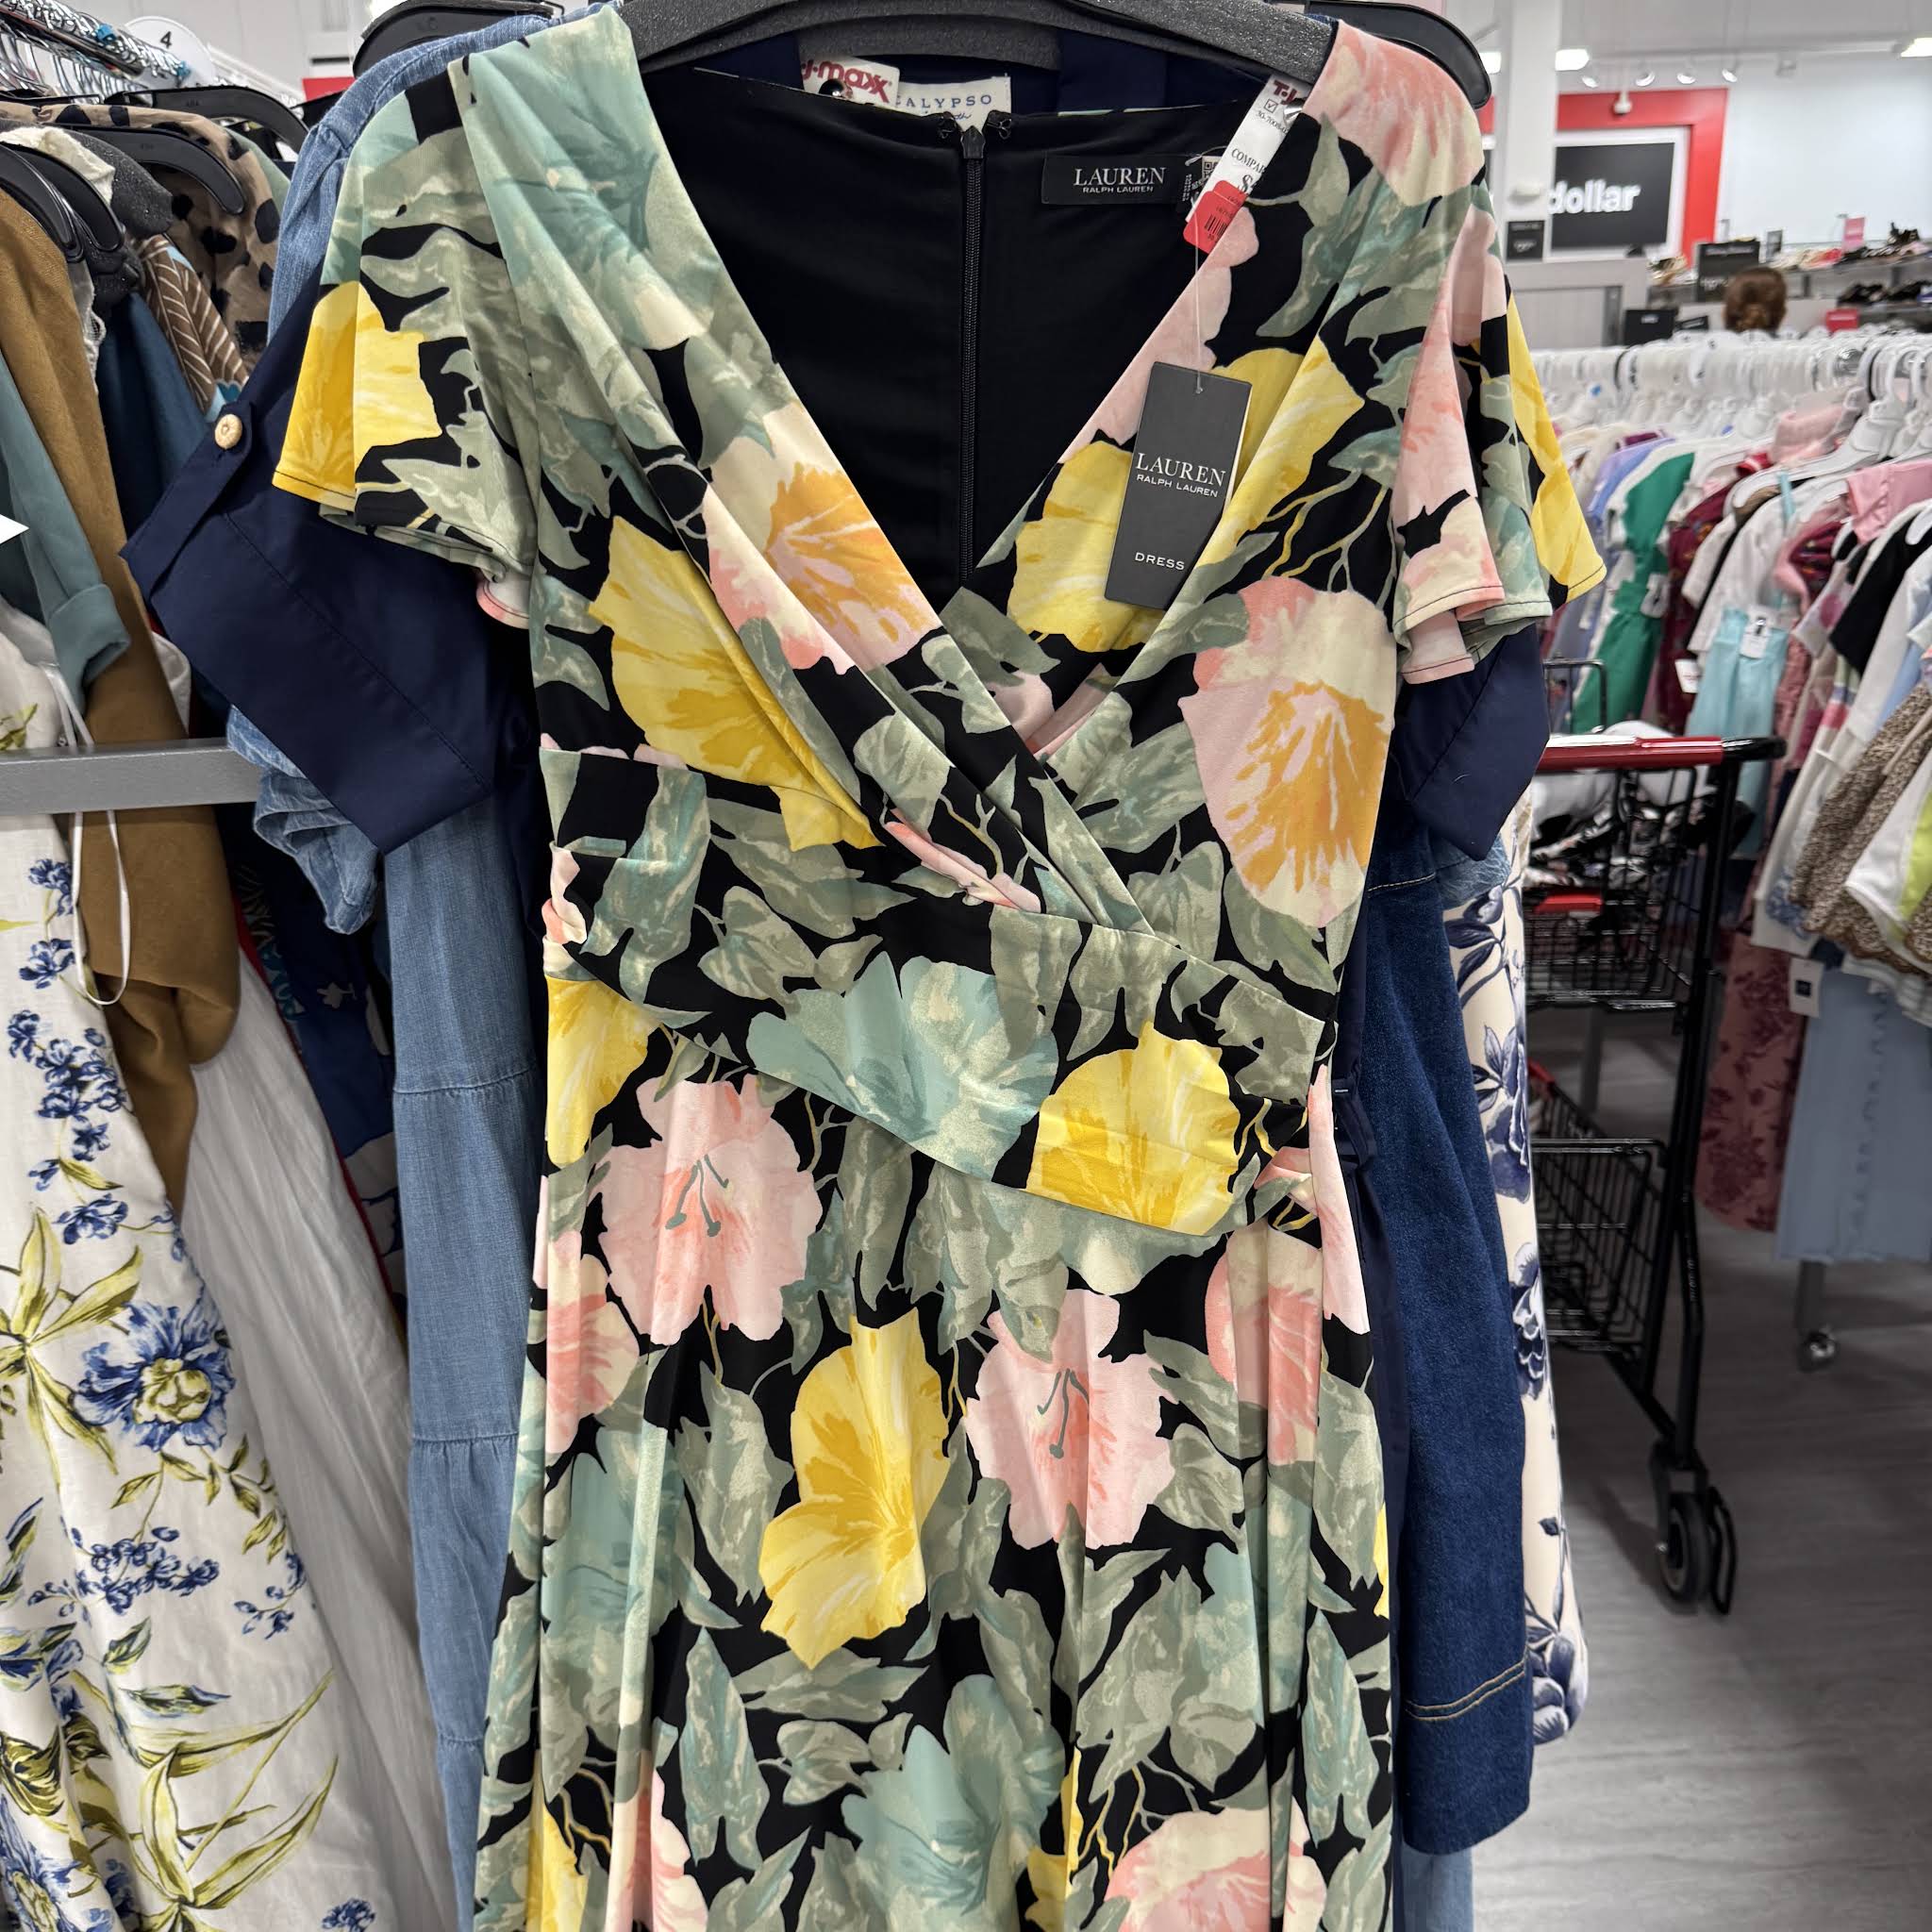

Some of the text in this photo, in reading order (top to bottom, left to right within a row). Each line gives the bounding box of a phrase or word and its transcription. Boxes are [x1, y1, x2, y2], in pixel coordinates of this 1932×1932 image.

[159, 30, 173, 49] 4
[1074, 167, 1167, 187] LAUREN
[1547, 178, 1641, 214] dollar
[1135, 453, 1226, 487] LAUREN
[1136, 474, 1219, 498] RALPH LAUREN
[1135, 552, 1186, 571] DRESS
